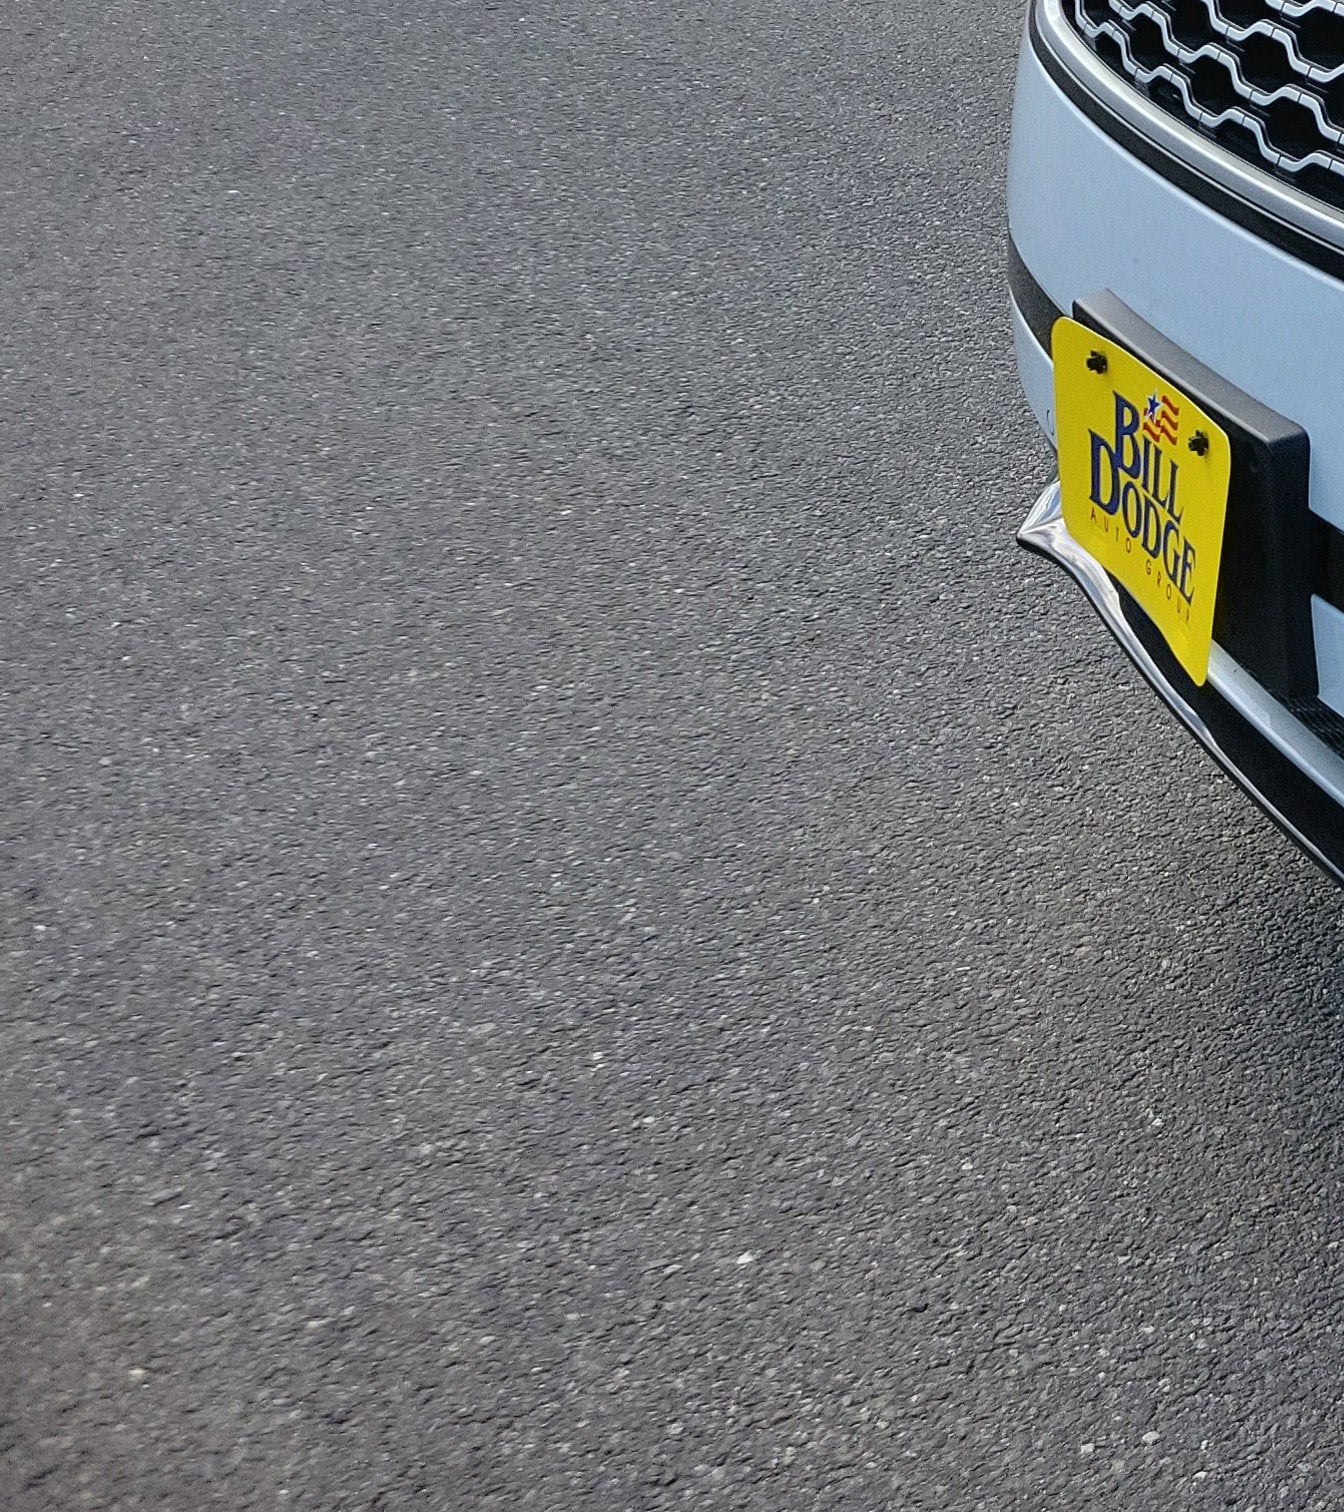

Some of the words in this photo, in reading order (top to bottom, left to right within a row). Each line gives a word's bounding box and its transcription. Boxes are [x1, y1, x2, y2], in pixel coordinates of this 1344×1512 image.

[1087, 427, 1197, 606] DODGE
[1112, 389, 1185, 527] BILL
[1090, 506, 1133, 555] AUTO
[1145, 558, 1191, 624] GROUP
